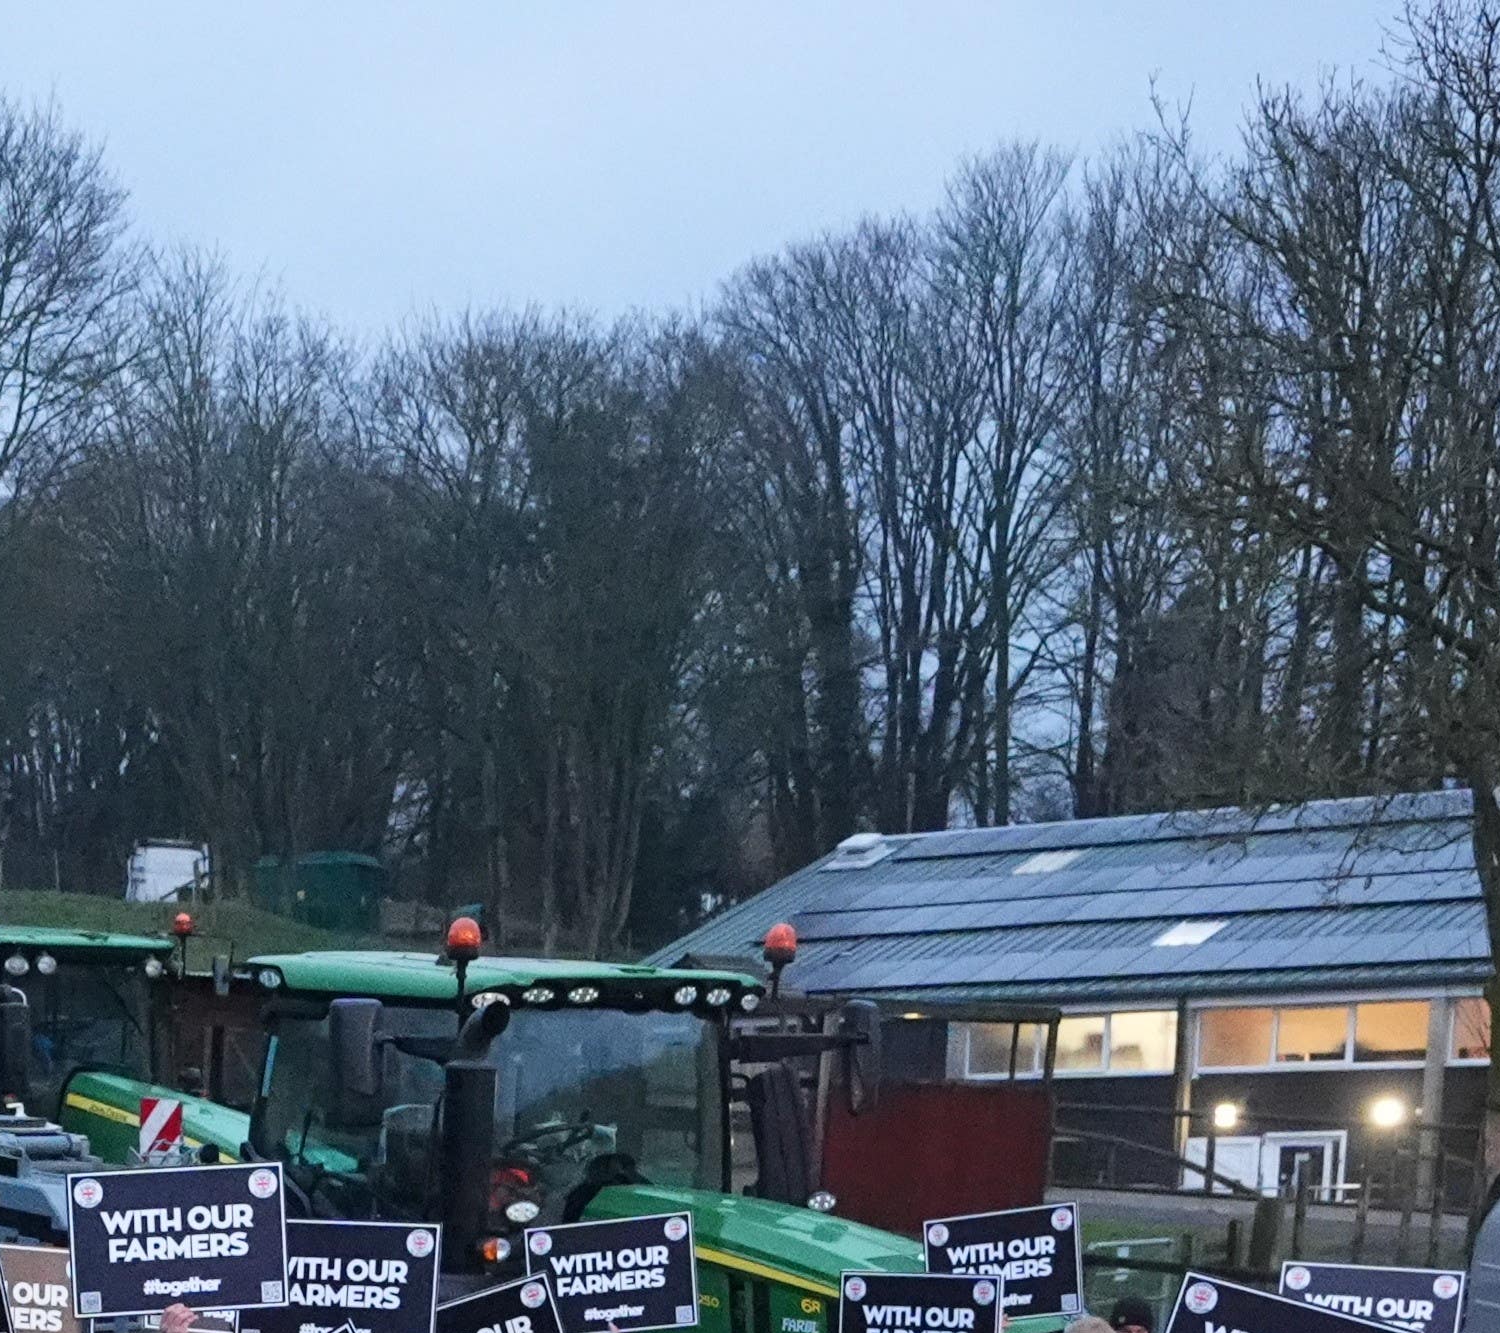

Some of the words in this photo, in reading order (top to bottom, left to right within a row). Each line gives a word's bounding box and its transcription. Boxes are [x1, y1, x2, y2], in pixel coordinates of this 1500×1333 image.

[100, 1207, 182, 1235] WITH
[187, 1204, 253, 1230] OUR
[109, 1232, 249, 1263] FARMERS
[550, 1251, 613, 1275] WITH
[617, 1246, 669, 1268] OUR
[143, 1276, 221, 1297] #together
[557, 1268, 665, 1297] FARMERS
[862, 1305, 921, 1326] WITH
[925, 1307, 974, 1328] OUR
